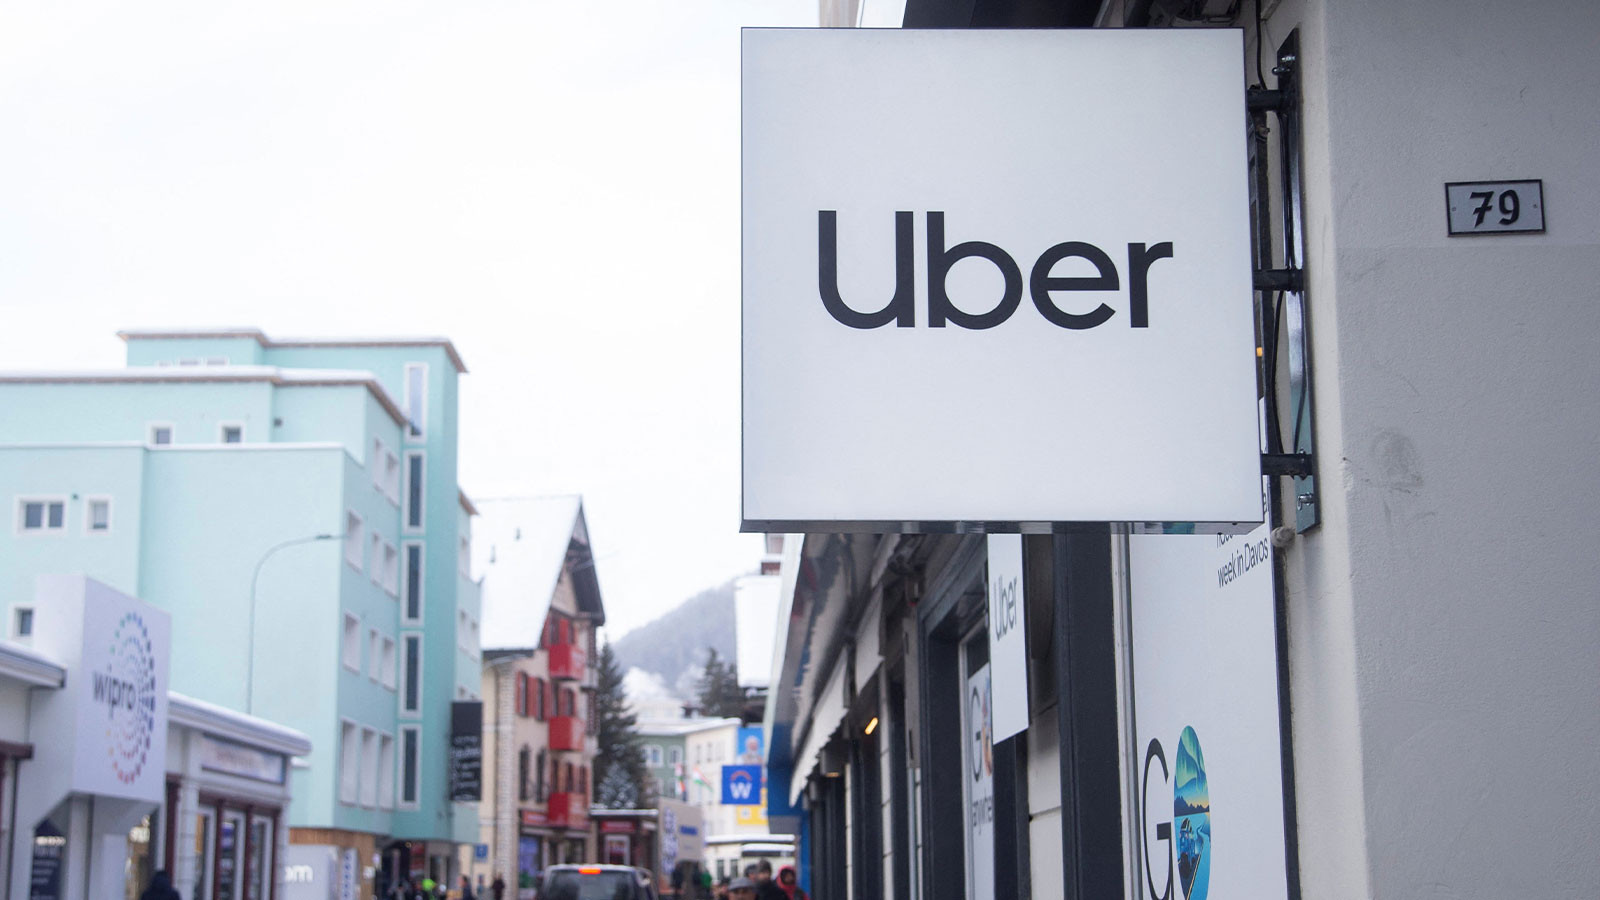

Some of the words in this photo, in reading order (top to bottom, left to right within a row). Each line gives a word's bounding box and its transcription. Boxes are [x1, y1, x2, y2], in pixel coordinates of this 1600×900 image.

[1469, 189, 1520, 229] 79
[818, 210, 1174, 330] Uber
[1217, 552, 1237, 589] week
[1236, 548, 1244, 577] in
[1244, 538, 1269, 572] Davos
[993, 574, 1018, 642] Uber
[92, 663, 137, 720] wipro
